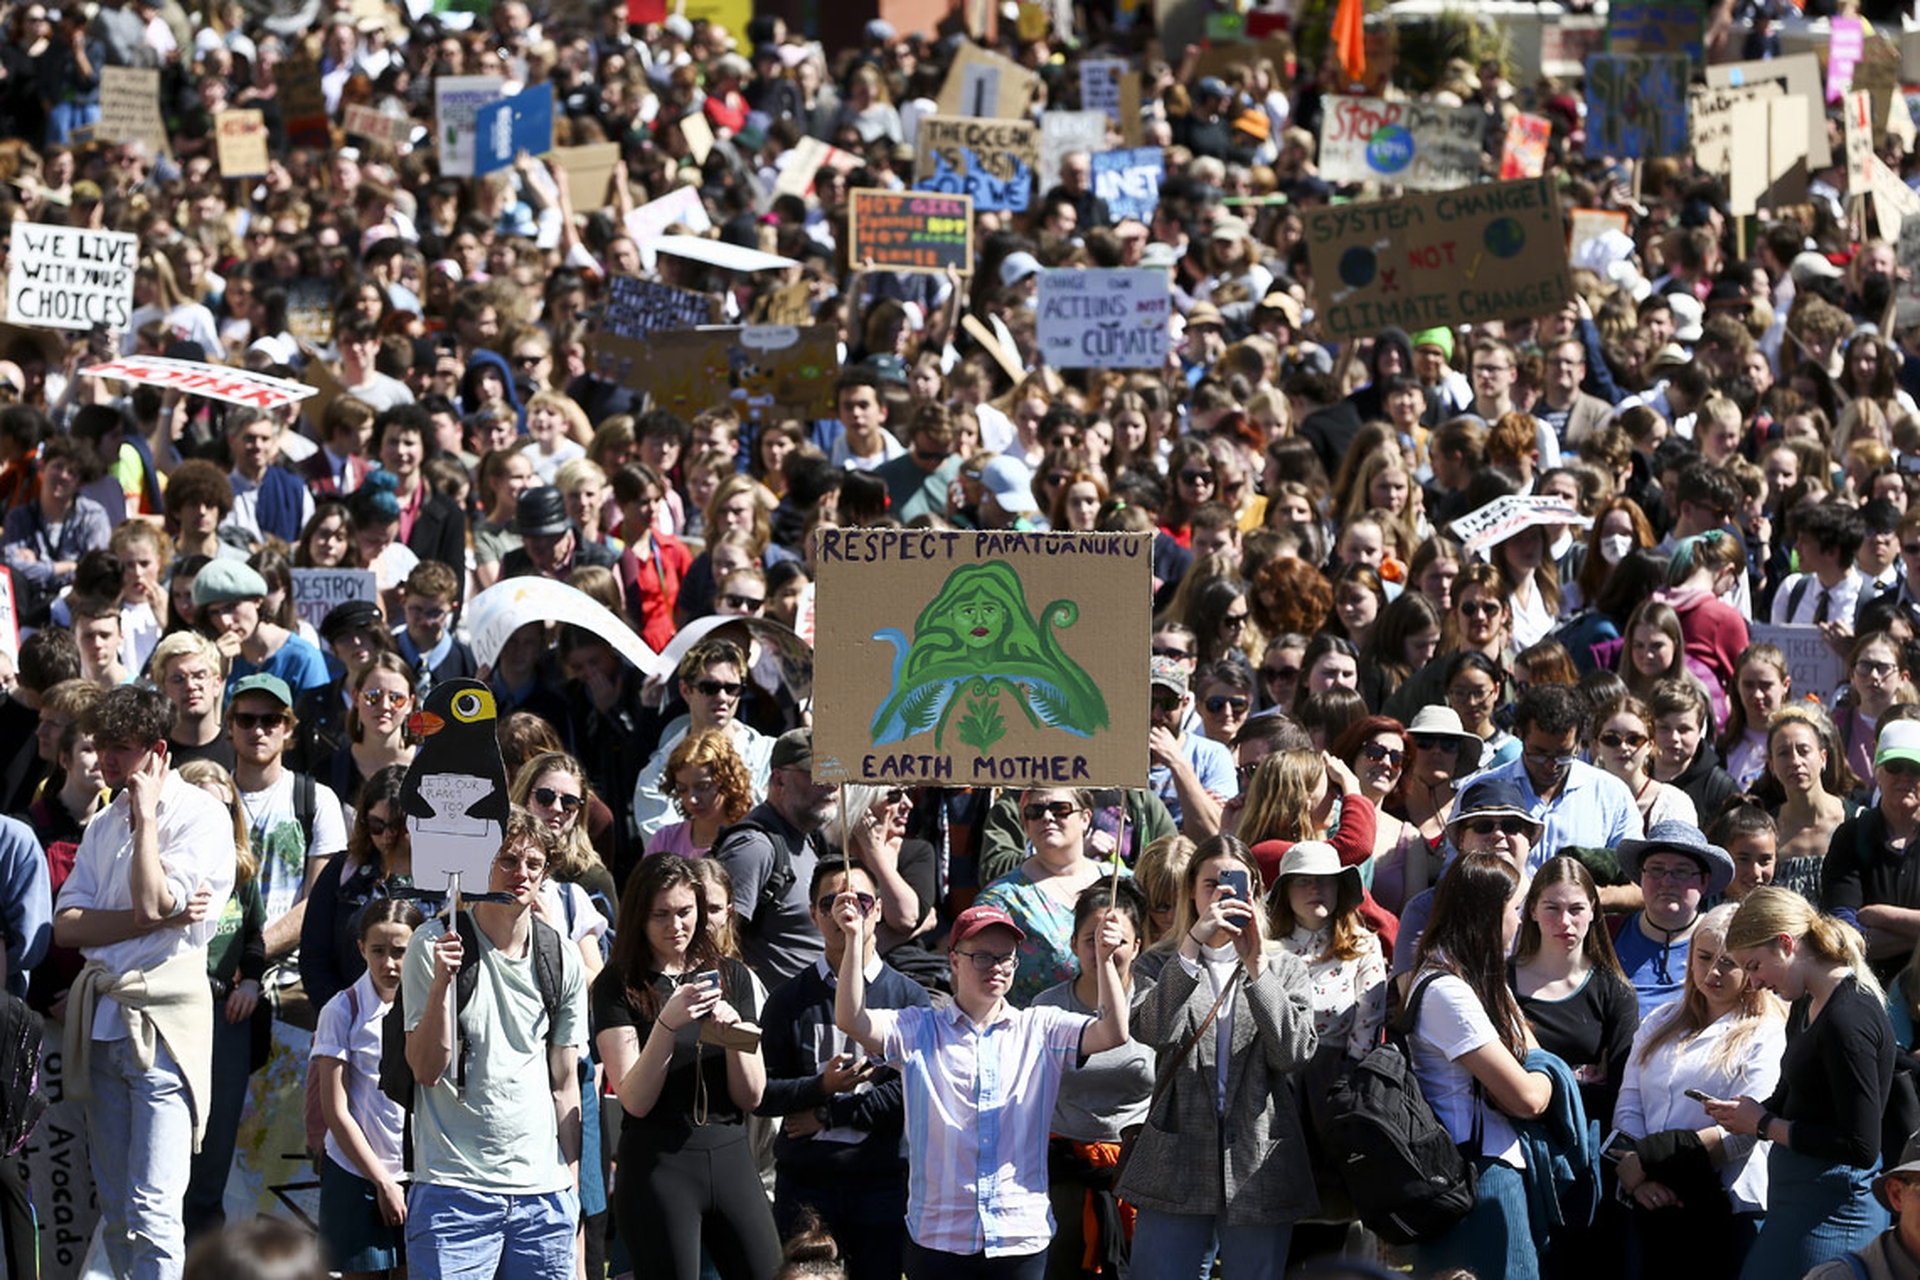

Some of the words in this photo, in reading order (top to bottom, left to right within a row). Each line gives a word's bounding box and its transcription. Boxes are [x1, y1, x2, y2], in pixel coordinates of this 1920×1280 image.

[927, 121, 962, 143] THE
[964, 124, 1030, 147] OCEAN
[1329, 99, 1402, 142] STOP
[856, 196, 903, 216] HOT
[909, 198, 964, 216] GIRL
[1311, 204, 1425, 244] SYSTEM
[1435, 176, 1551, 222] CHANGE!
[927, 215, 966, 235] NOT
[24, 233, 66, 259] WE
[78, 235, 136, 268] LIVE
[1407, 242, 1456, 270] NOT
[22, 260, 76, 284] WITH
[82, 267, 126, 289] YOUR
[17, 286, 128, 328] CHOICES
[1044, 295, 1128, 320] ACTIONS
[1136, 299, 1166, 312] NOT
[1327, 293, 1450, 335] CLIMATE
[1457, 273, 1565, 319] CHANGE!
[1081, 324, 1164, 357] CLIMATE
[823, 529, 960, 563] RESPECT
[293, 576, 364, 600] DESTROY
[1786, 638, 1829, 658] TREES
[1792, 663, 1820, 682] GET
[862, 754, 951, 779] EARTH
[973, 755, 1091, 781] MOTHER
[455, 779, 481, 791] OUR
[441, 801, 464, 812] TOO
[48, 1124, 83, 1267] Avocado
